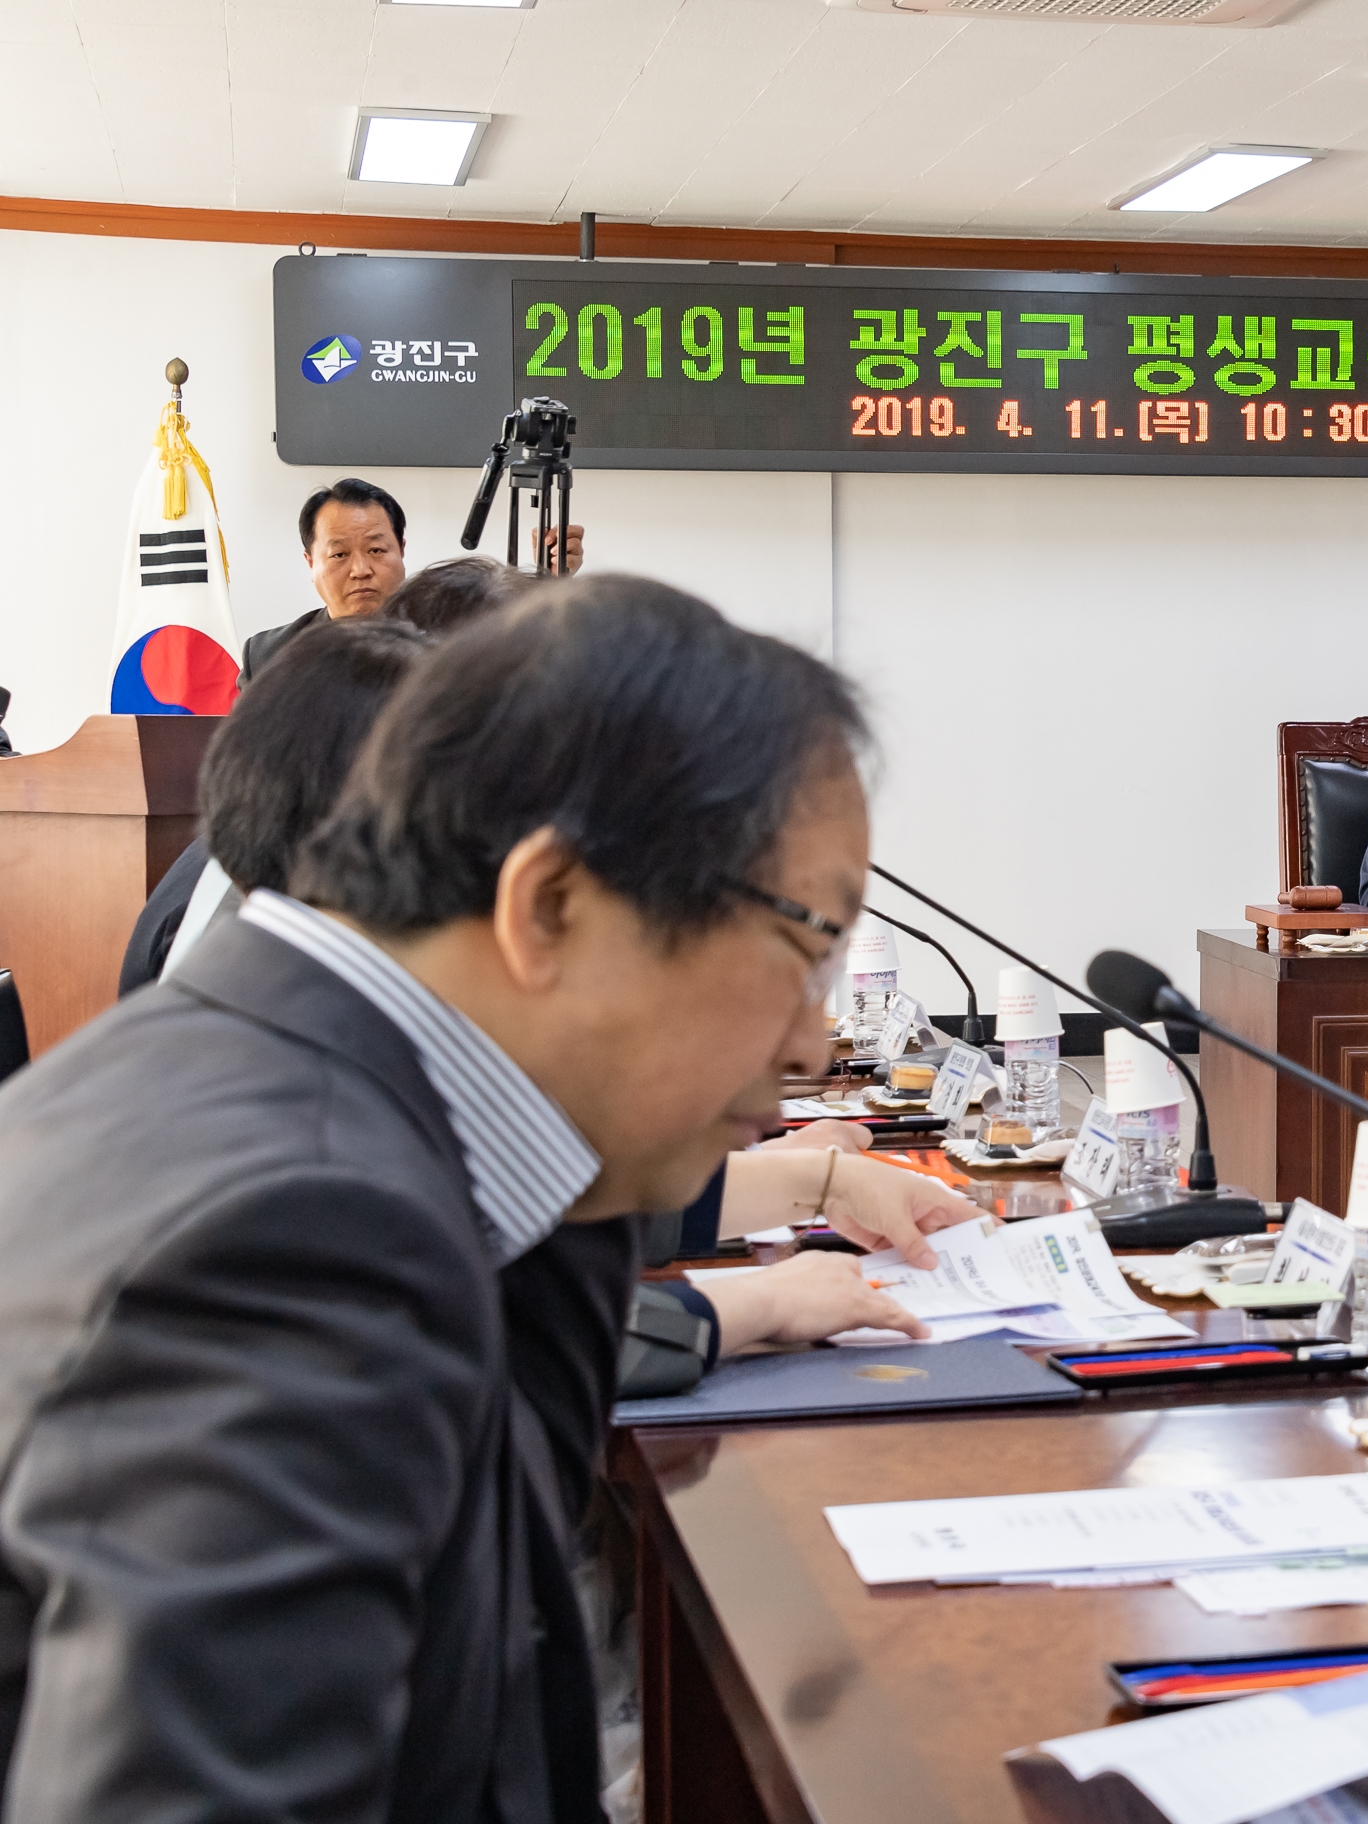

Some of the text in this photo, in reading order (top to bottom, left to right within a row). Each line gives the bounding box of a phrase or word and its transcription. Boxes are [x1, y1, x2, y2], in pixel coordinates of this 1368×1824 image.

[369, 340, 479, 367] 광진구
[525, 302, 805, 385] 2019년
[849, 308, 1088, 391] 광진구
[371, 369, 477, 383] GWANGJIN-GU
[850, 395, 966, 437] 2019.
[996, 399, 1033, 438] 4.
